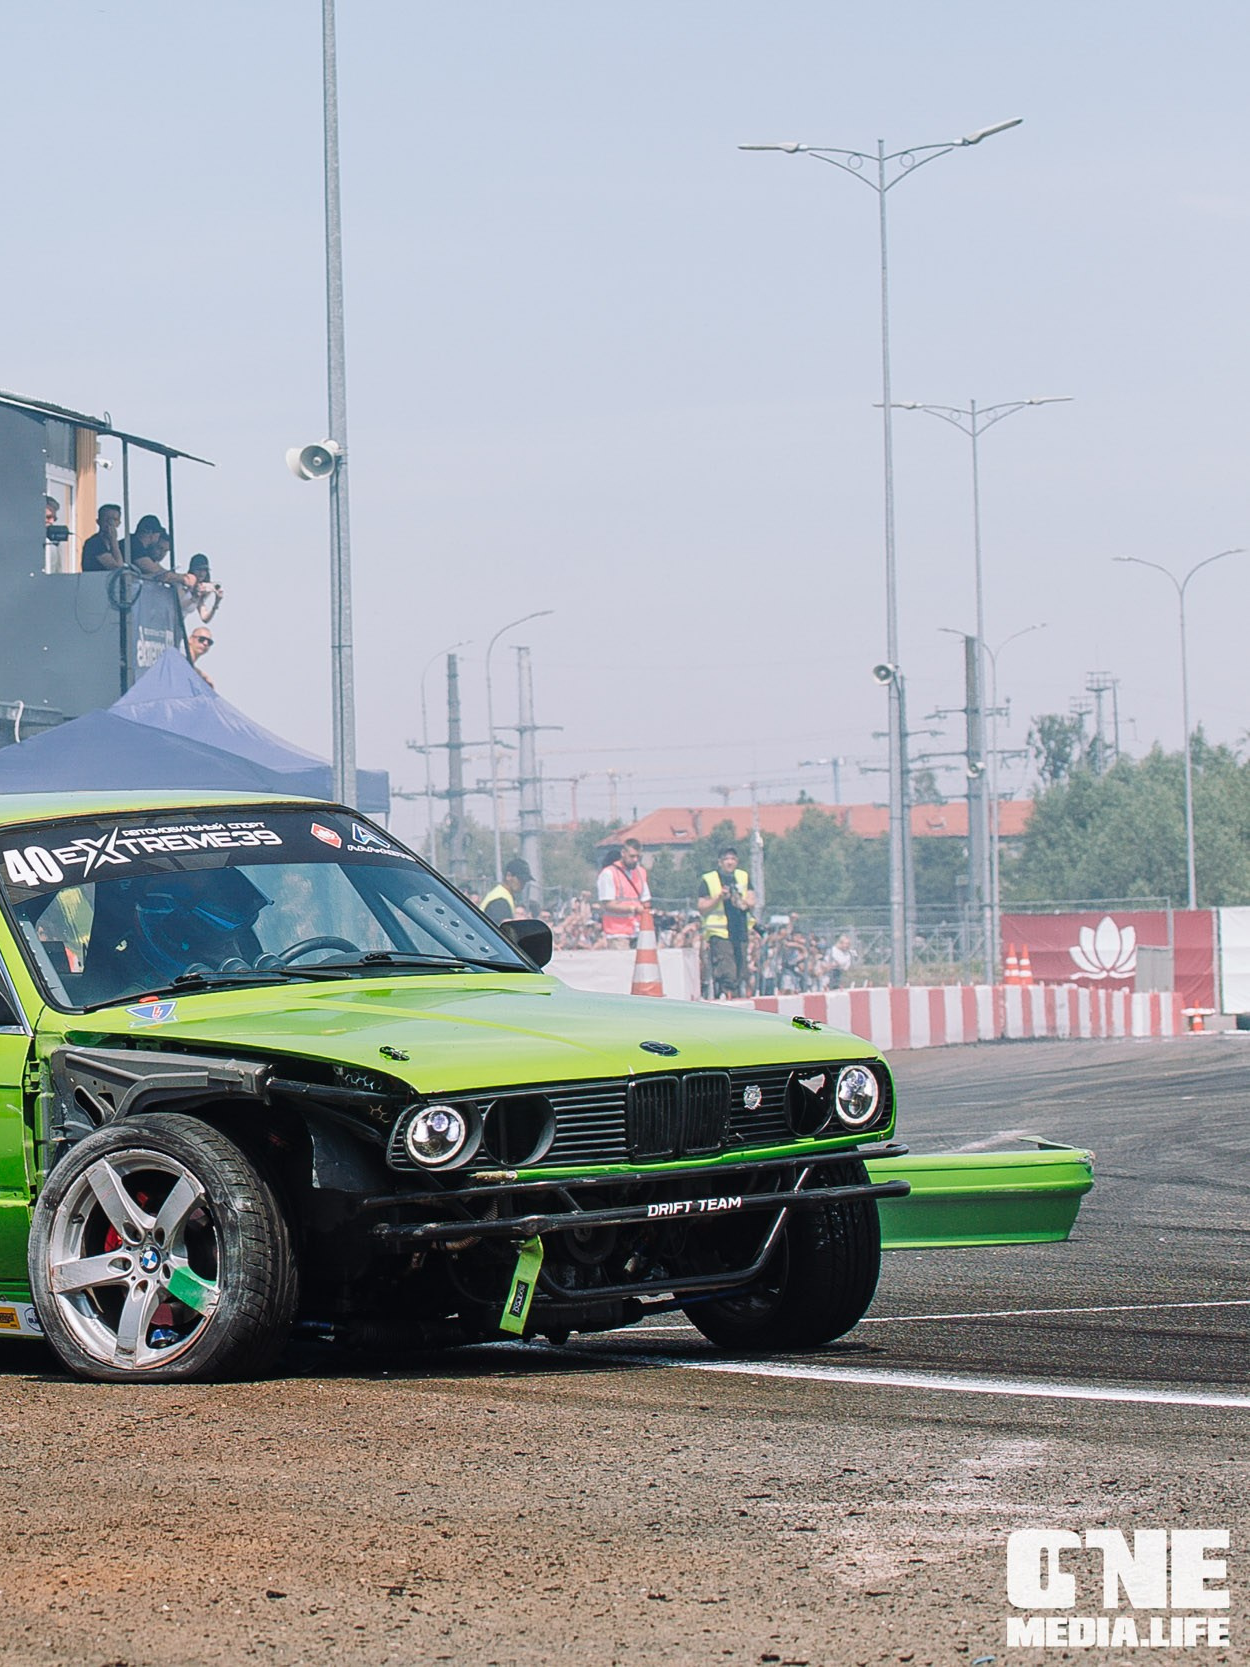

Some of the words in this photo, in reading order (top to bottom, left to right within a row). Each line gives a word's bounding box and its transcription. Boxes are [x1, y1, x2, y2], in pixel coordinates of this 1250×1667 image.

[121, 822, 225, 837] АВТОМОБИЛЬНЫЙ
[227, 821, 265, 831] СПОРТ
[2, 845, 64, 887] 40
[51, 826, 283, 878] EXTREME39
[647, 1201, 693, 1217] DRIFT
[698, 1196, 742, 1212] TEAM
